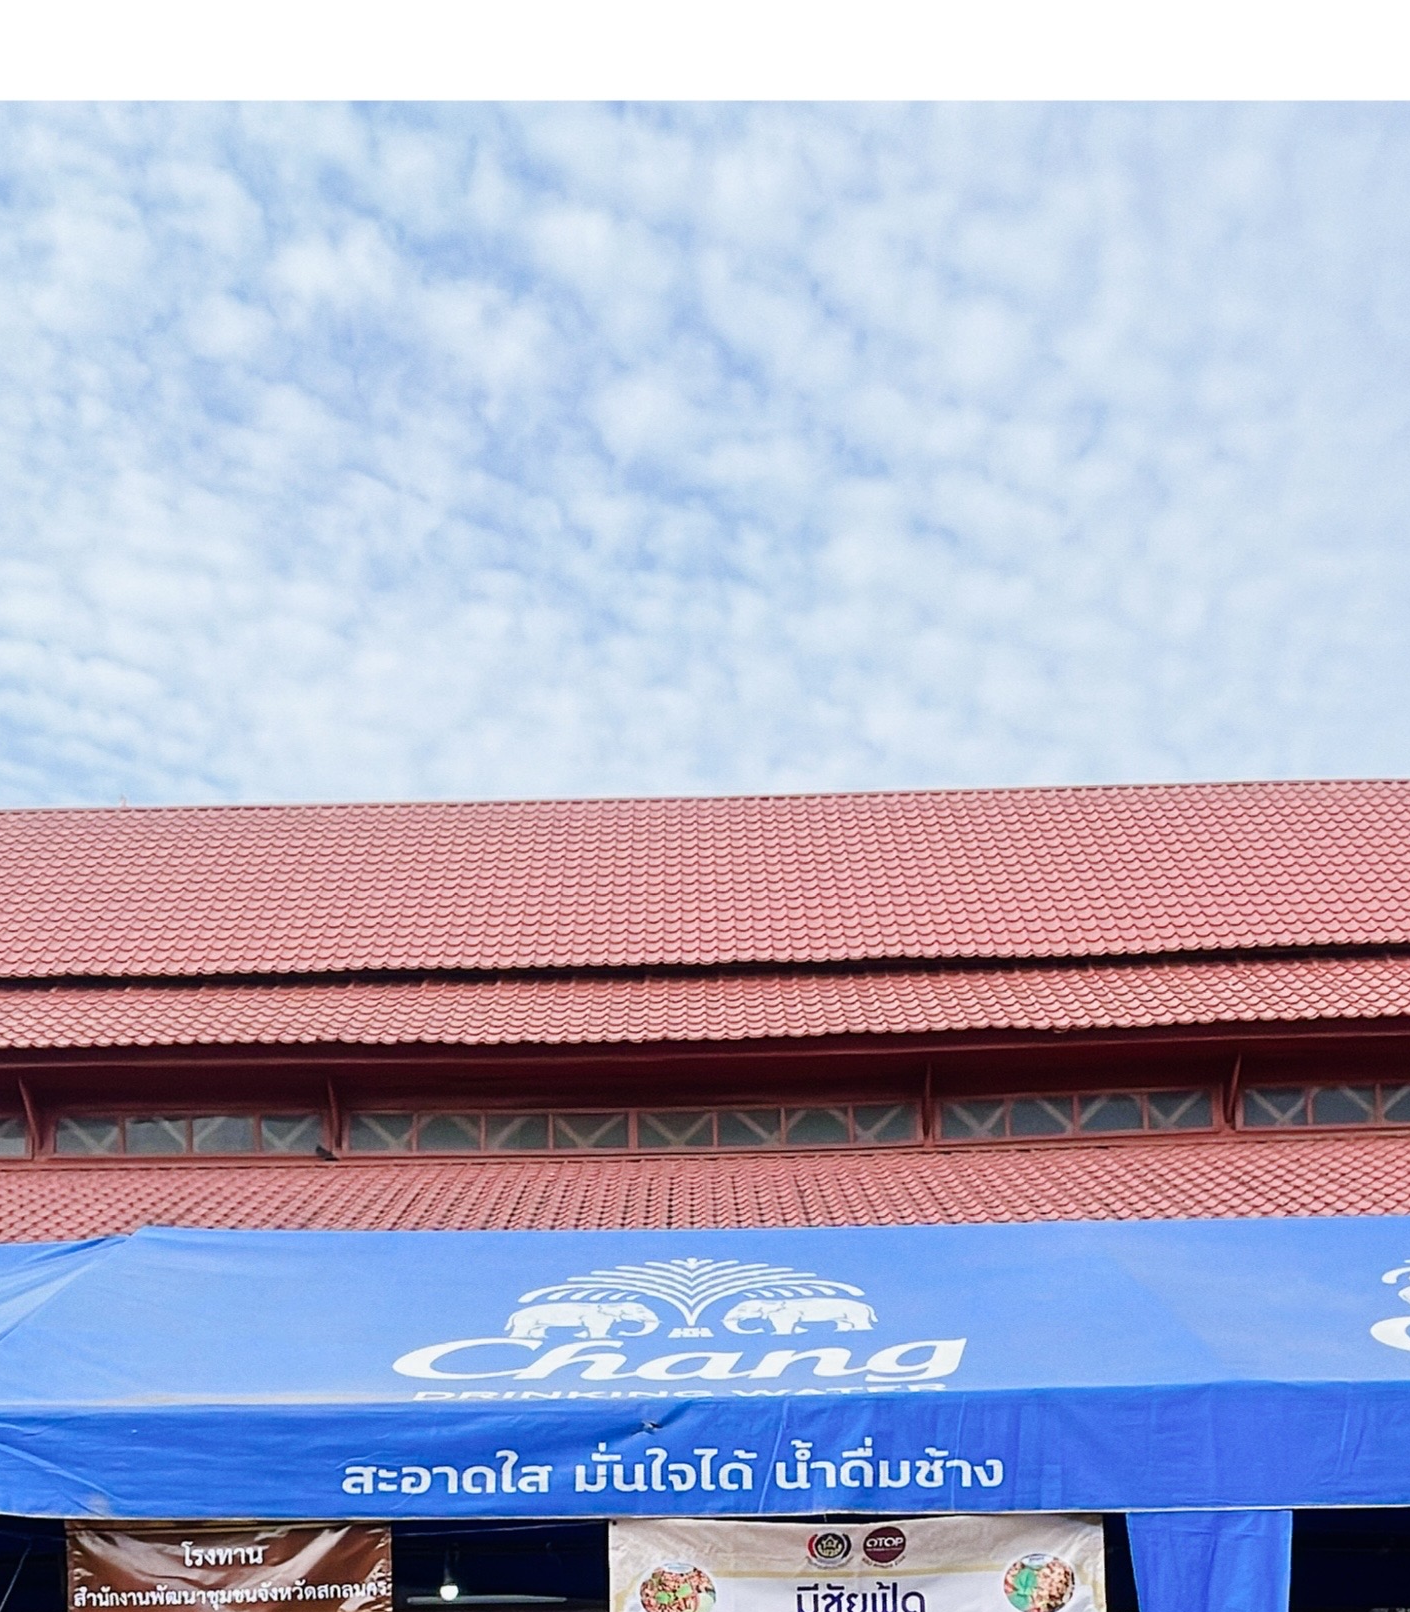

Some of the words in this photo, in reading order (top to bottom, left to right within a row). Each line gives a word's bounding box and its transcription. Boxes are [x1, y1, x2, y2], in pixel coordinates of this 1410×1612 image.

[391, 1336, 967, 1383] Chang
[342, 1450, 553, 1494] สะอาดใส
[575, 1442, 758, 1492] มั่นใจได้
[775, 1437, 1003, 1490] น้ำดื่มช้าง
[181, 1541, 264, 1567] โรงทาน
[865, 1536, 904, 1548] OTOP
